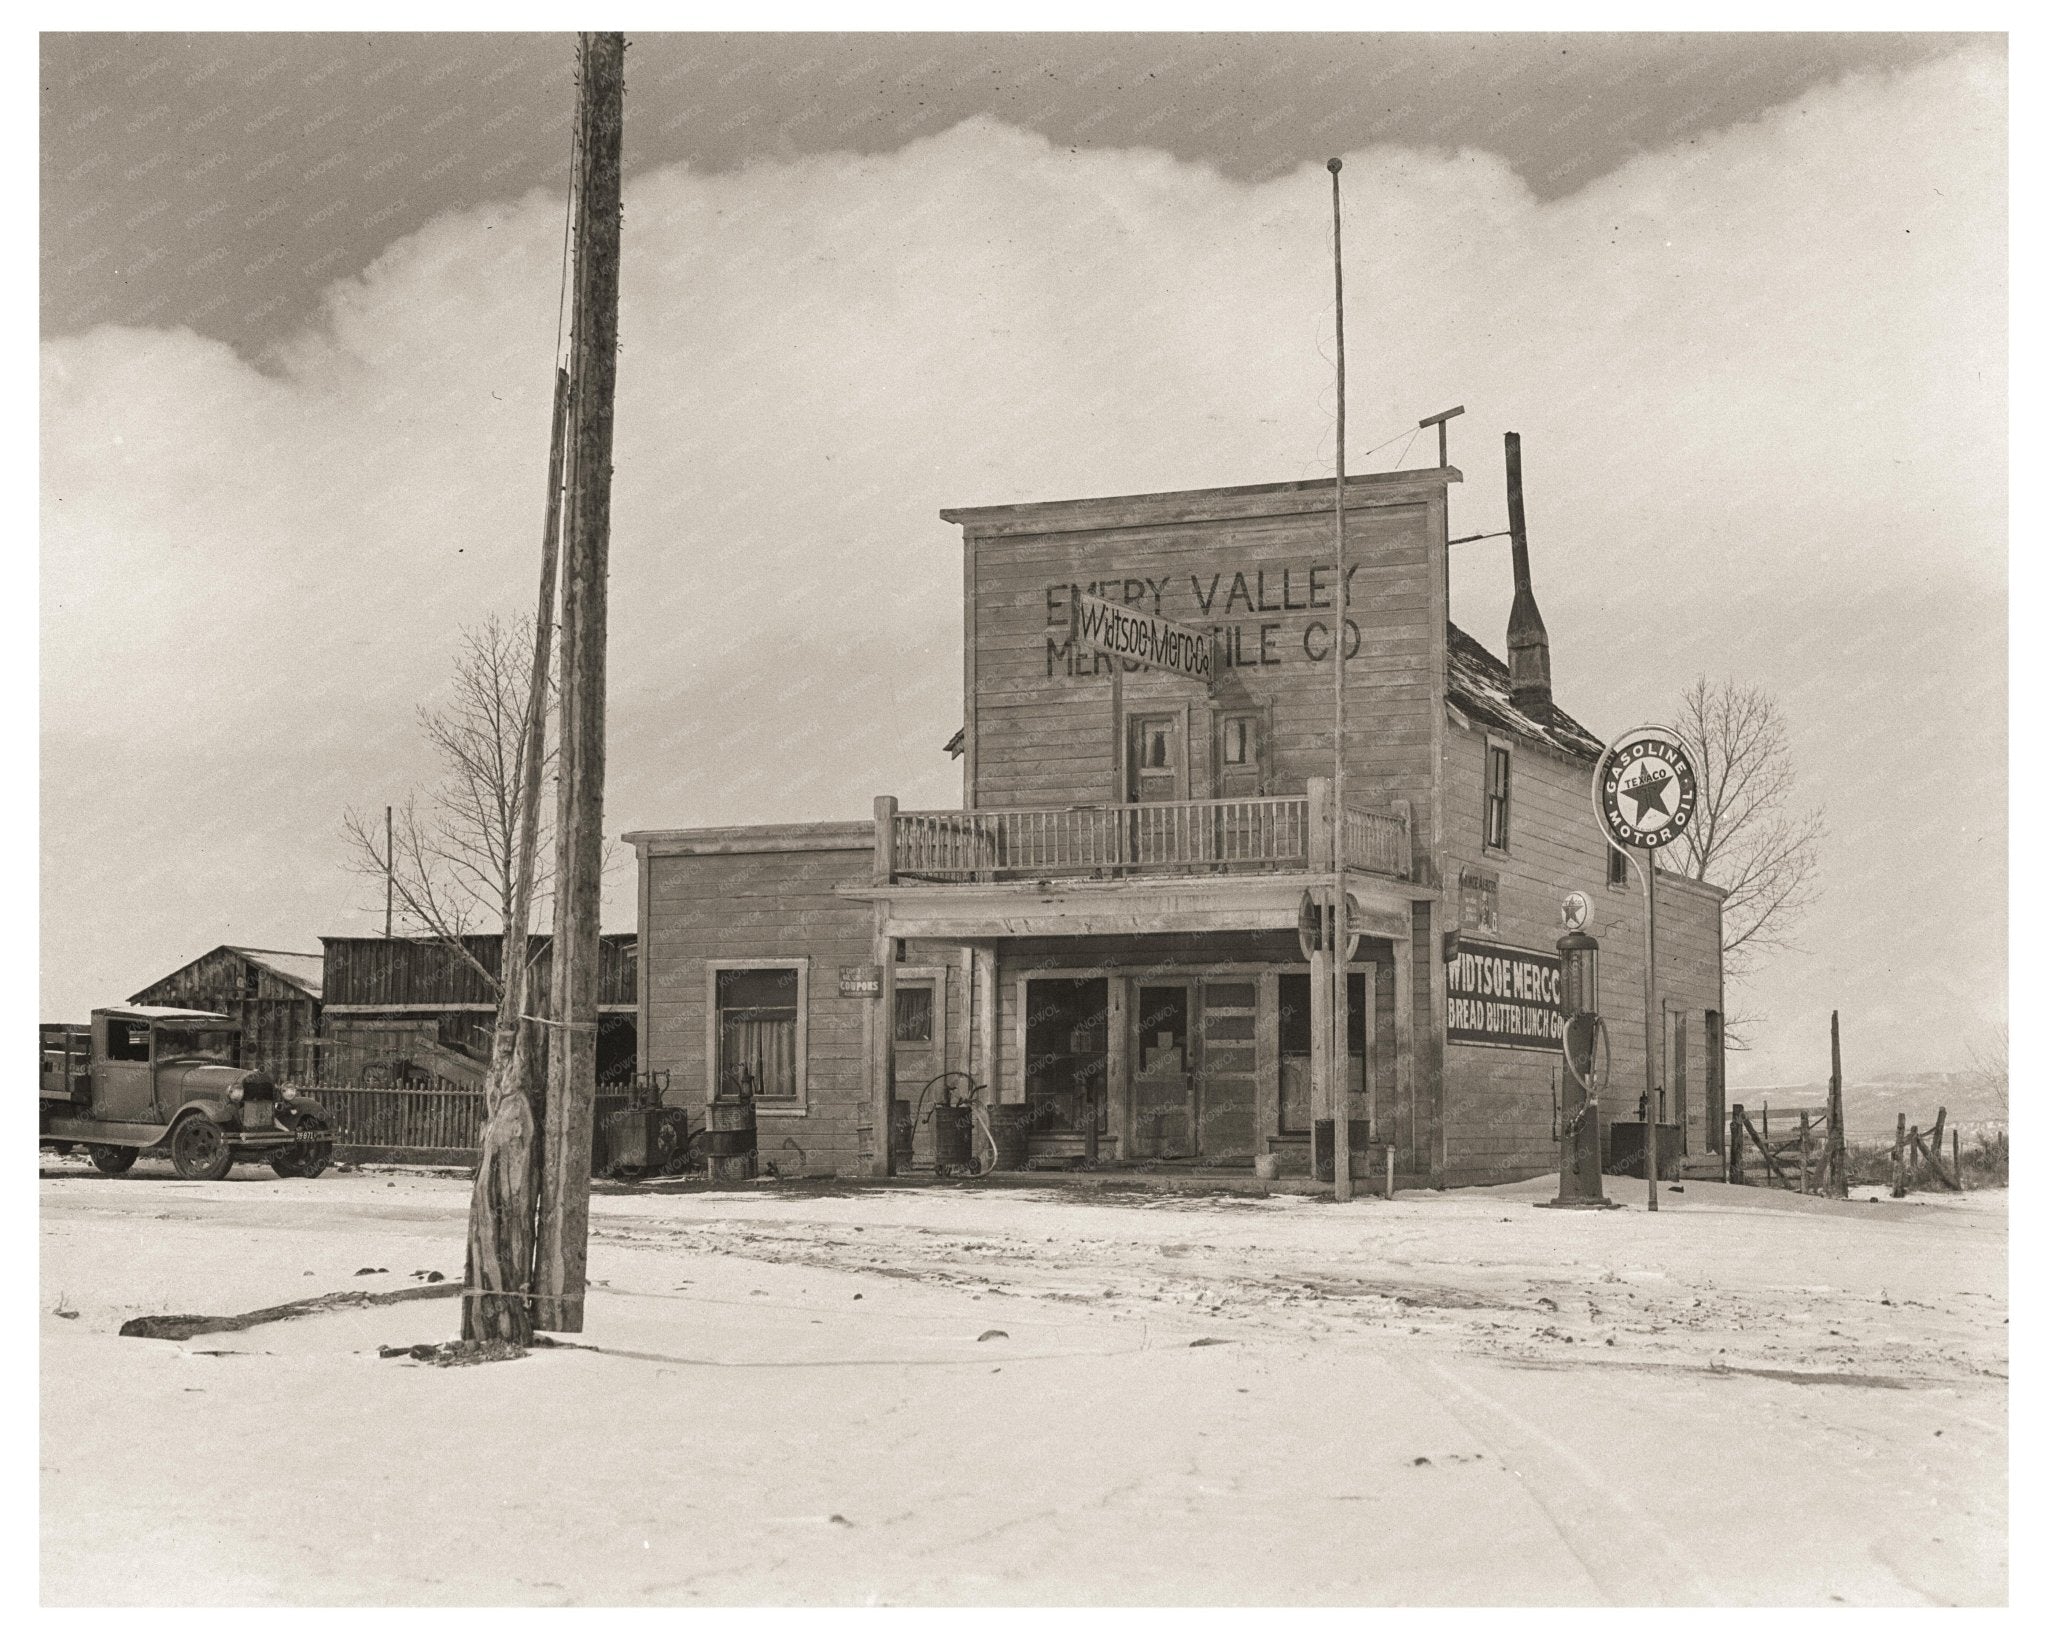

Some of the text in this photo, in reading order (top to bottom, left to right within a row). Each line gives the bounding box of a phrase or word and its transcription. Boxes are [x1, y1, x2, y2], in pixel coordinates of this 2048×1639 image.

[1191, 562, 1360, 615] VALLEY
[1303, 619, 1361, 662] CO
[1606, 743, 1687, 793] GASOLINE
[1624, 769, 1666, 788] TEXACO
[1609, 790, 1693, 846] MOTOR OIL
[1448, 952, 1511, 997] WIDTSOE
[1448, 998, 1484, 1030] BREAD
[1486, 1002, 1521, 1034] BUTTER
[1522, 1006, 1549, 1037] LUNCH
